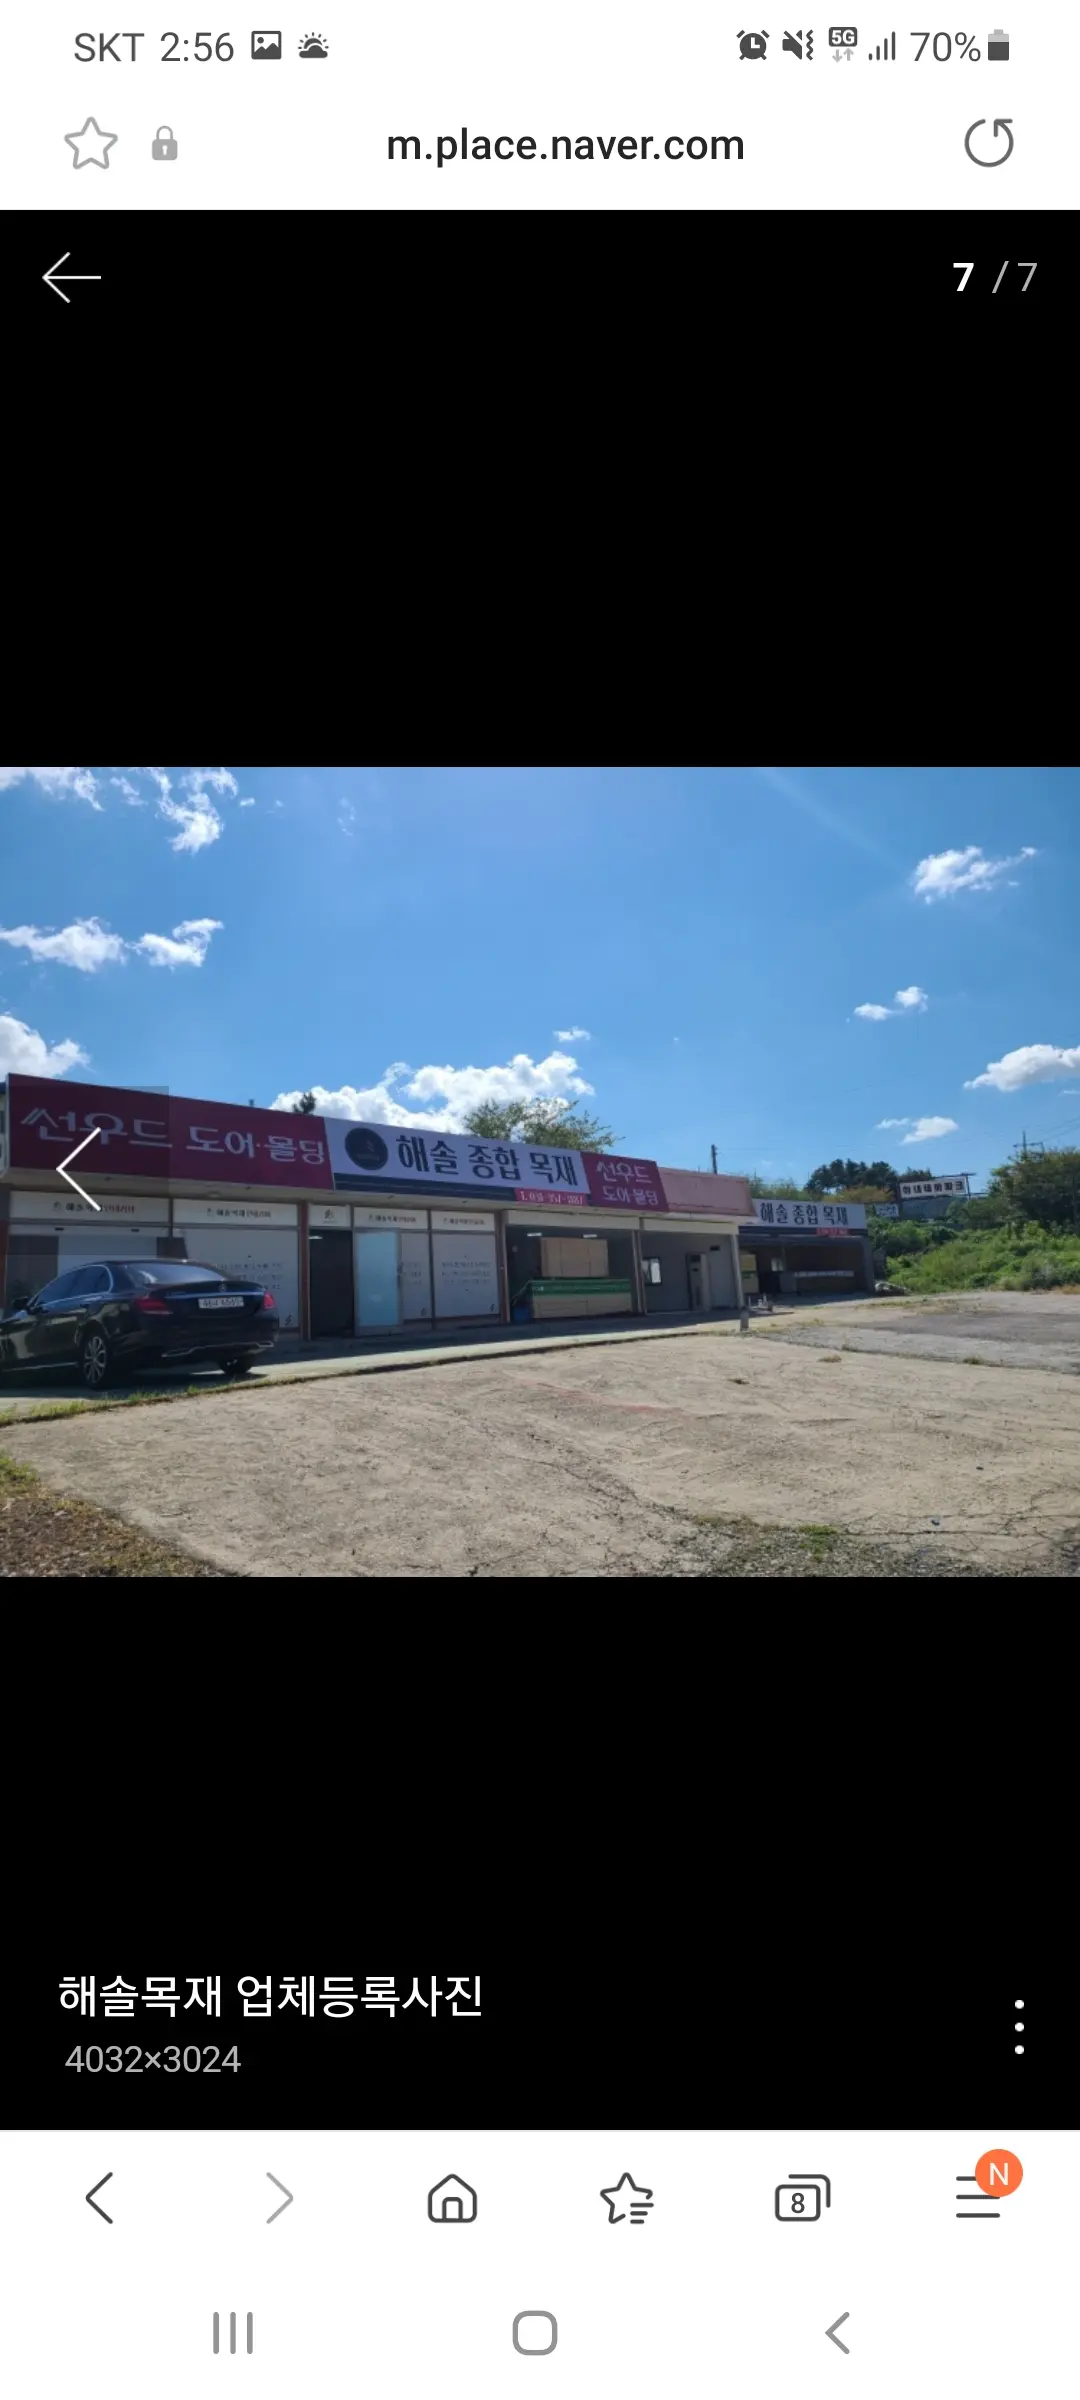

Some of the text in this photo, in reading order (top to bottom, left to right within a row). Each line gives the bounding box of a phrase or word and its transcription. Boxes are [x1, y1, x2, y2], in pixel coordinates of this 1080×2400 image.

[74, 32, 235, 62] SKT 2:56
[831, 29, 855, 45] 5G
[910, 31, 982, 62] 70%
[386, 126, 745, 169] m.place.naver.com
[396, 1135, 579, 1187] 해솔 종합 목재
[760, 1202, 848, 1226] 해솔 종합 목재
[990, 2162, 1009, 2186] N
[790, 2192, 806, 2214] 8
